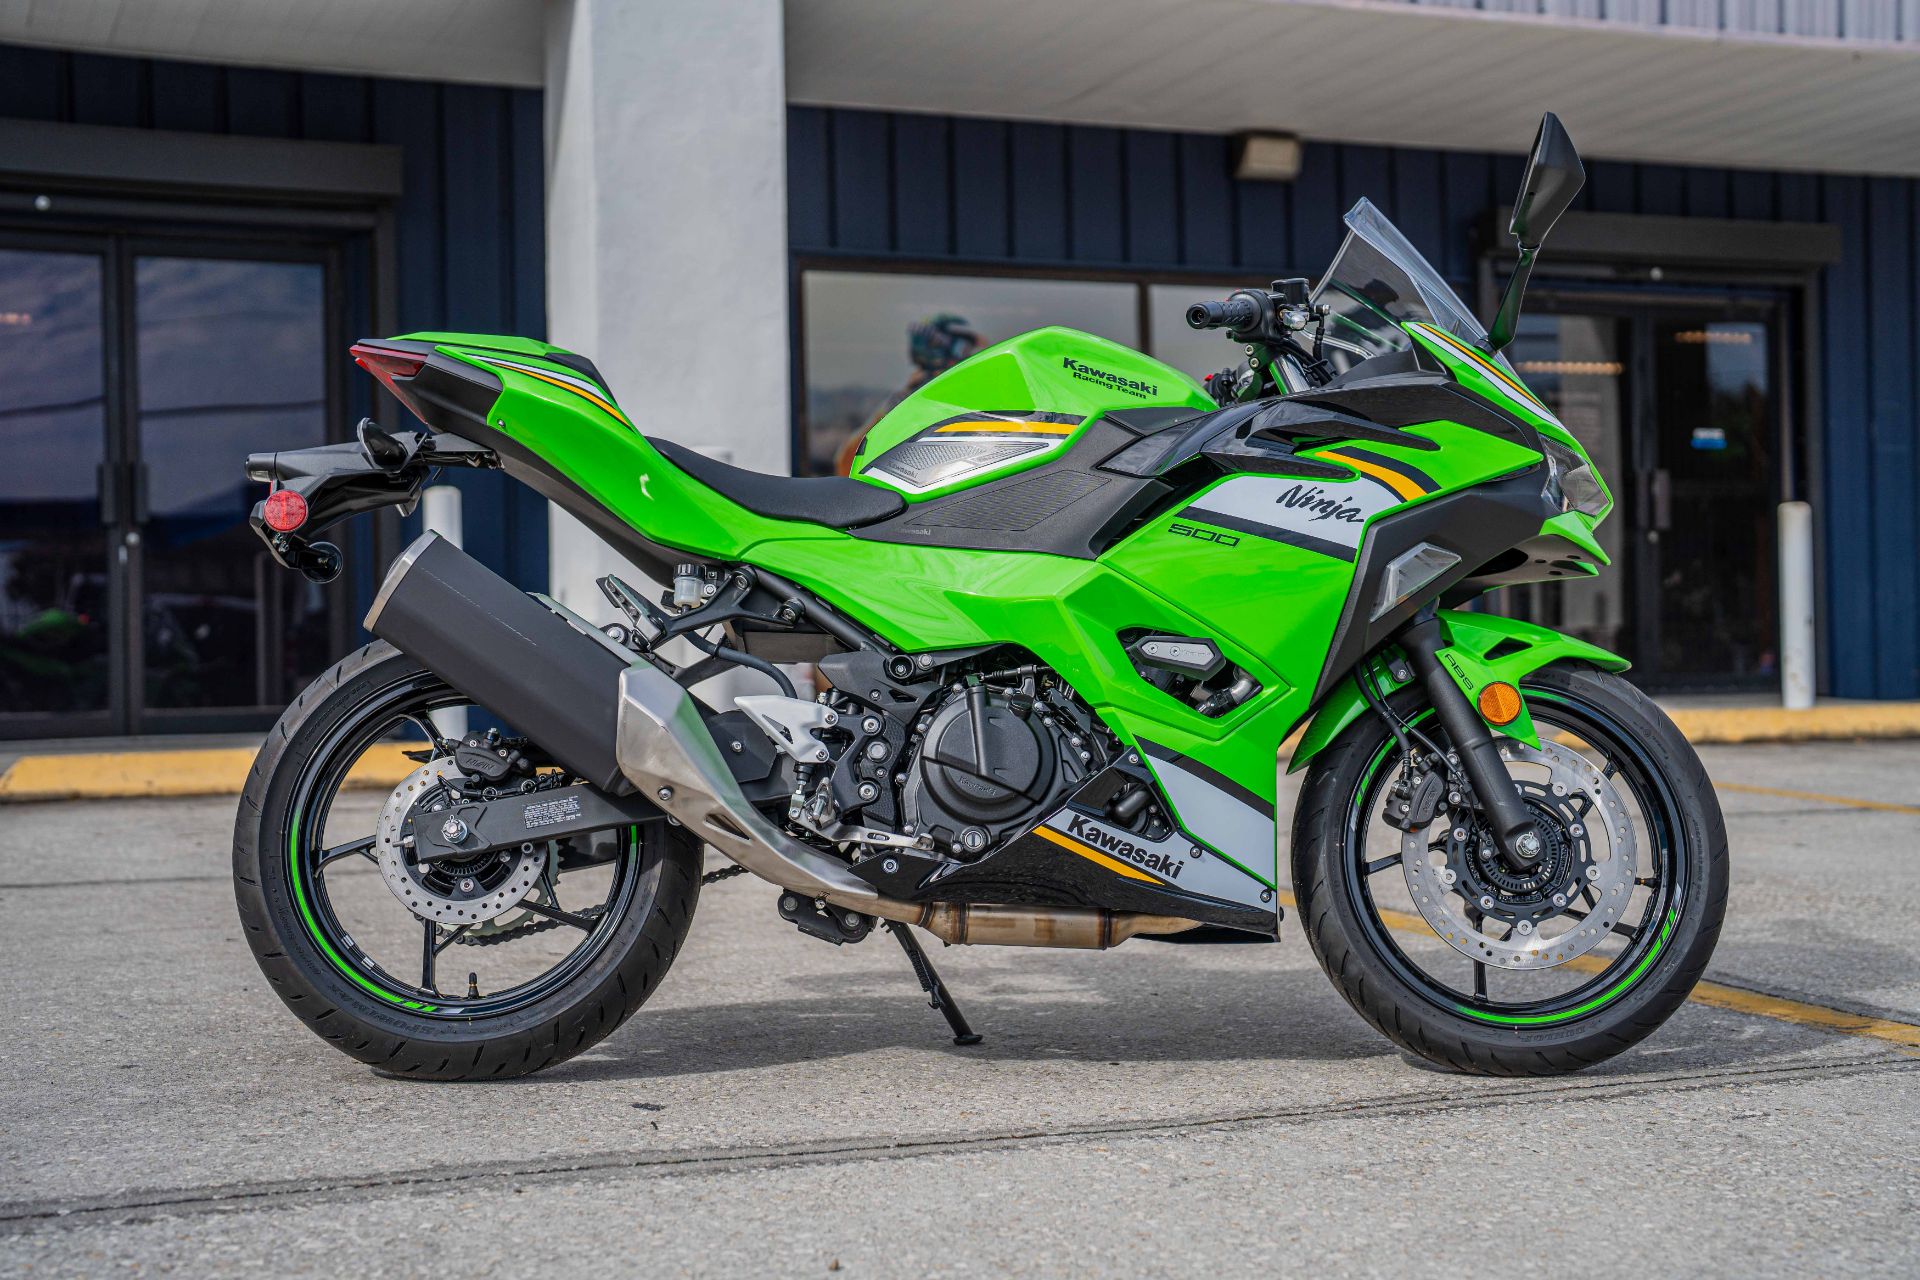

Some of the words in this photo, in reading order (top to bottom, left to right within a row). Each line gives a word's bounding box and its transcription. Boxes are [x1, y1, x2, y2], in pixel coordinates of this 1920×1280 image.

[1063, 356, 1158, 396] Kawasaki
[1073, 372, 1113, 390] Racing
[1115, 385, 1147, 399] Team
[1275, 485, 1364, 523] Ninja
[1167, 523, 1241, 547] 500
[1444, 653, 1474, 691] ABS
[1066, 814, 1185, 880] Kawasaki
